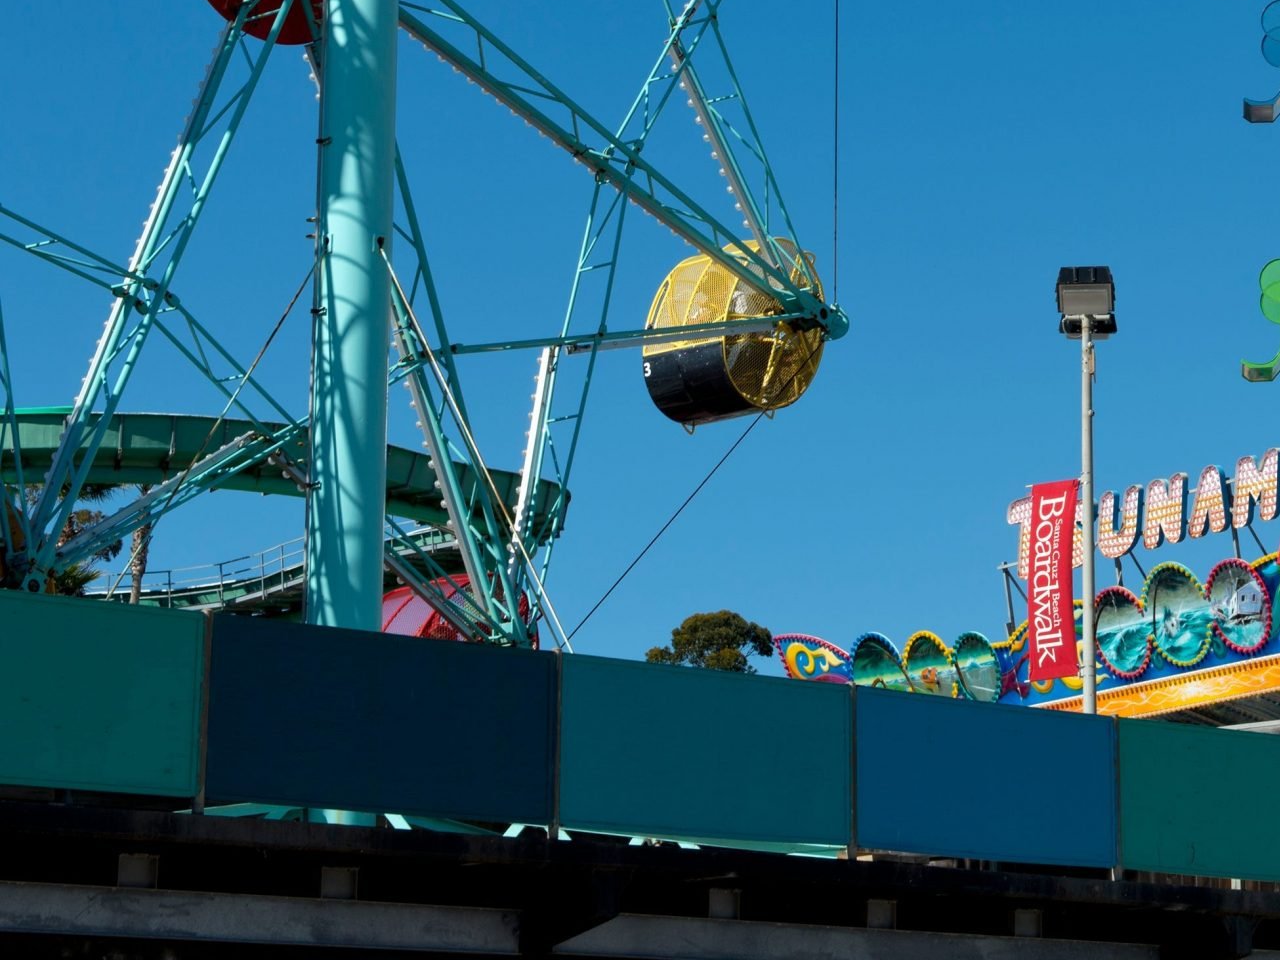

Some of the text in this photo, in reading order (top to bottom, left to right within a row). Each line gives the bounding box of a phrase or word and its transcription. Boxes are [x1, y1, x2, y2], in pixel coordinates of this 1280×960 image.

[643, 361, 651, 378] 3
[1033, 490, 1067, 668] Boardwalk
[1051, 518, 1063, 628] Santa Cruz Beach
